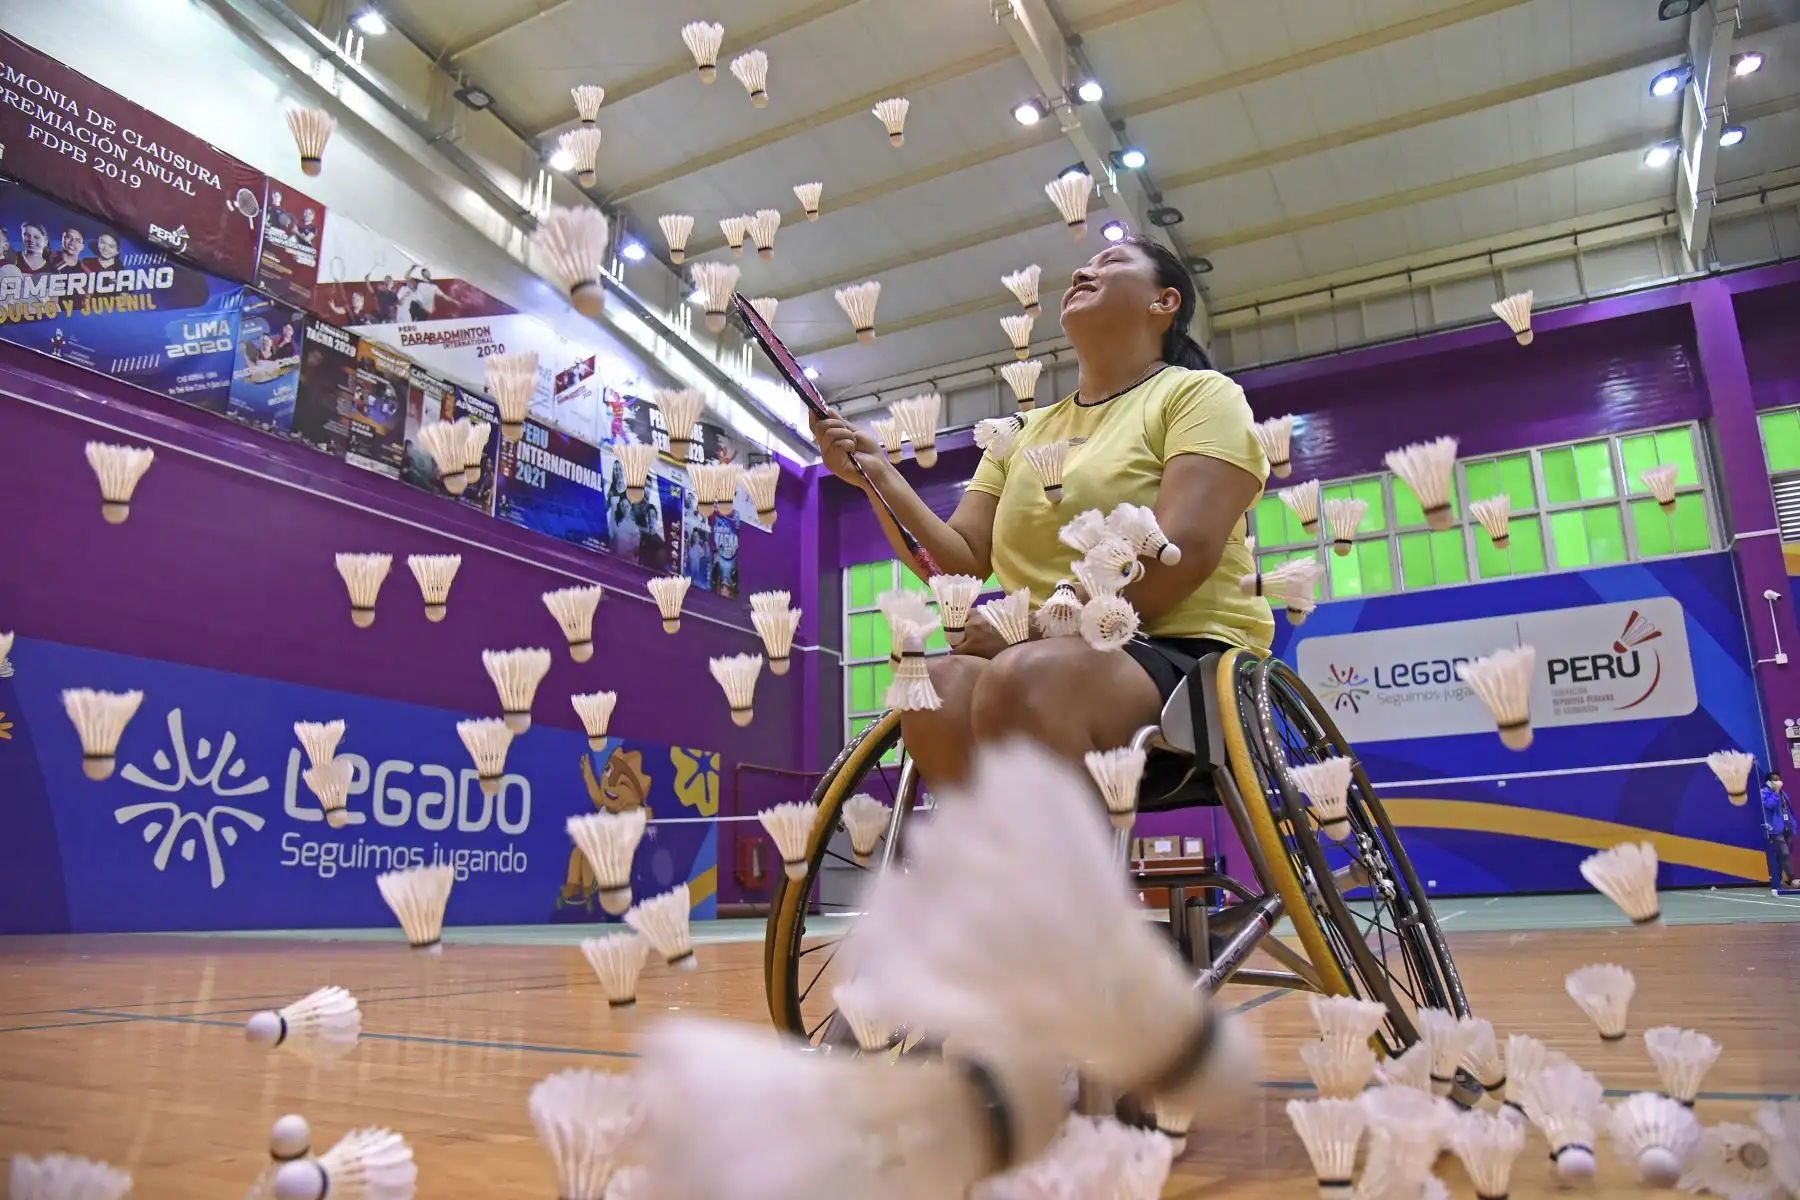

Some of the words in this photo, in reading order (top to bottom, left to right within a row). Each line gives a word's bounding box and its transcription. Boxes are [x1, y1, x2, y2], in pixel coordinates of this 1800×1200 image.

[28, 124, 87, 163] FDPB
[93, 157, 142, 188] 2019
[86, 108, 116, 135] DE
[122, 129, 222, 190] CLAUSURA
[132, 156, 196, 196] ANUAL
[2, 266, 174, 300] AMERICANO
[62, 299, 74, 318] Y
[81, 293, 157, 316] JUVENIL
[183, 320, 231, 340] LIMA
[400, 326, 491, 346] PARABADMINTON
[443, 338, 495, 349] INTERNATIONAL
[165, 338, 233, 358] 2020
[476, 343, 505, 358] 2020
[515, 460, 546, 489] 2021
[516, 440, 603, 492] INTERNATIONAL
[1377, 689, 1441, 707] Seguimos
[1443, 685, 1476, 701] juga
[280, 831, 425, 879] Seguimos
[433, 842, 528, 881] jugando
